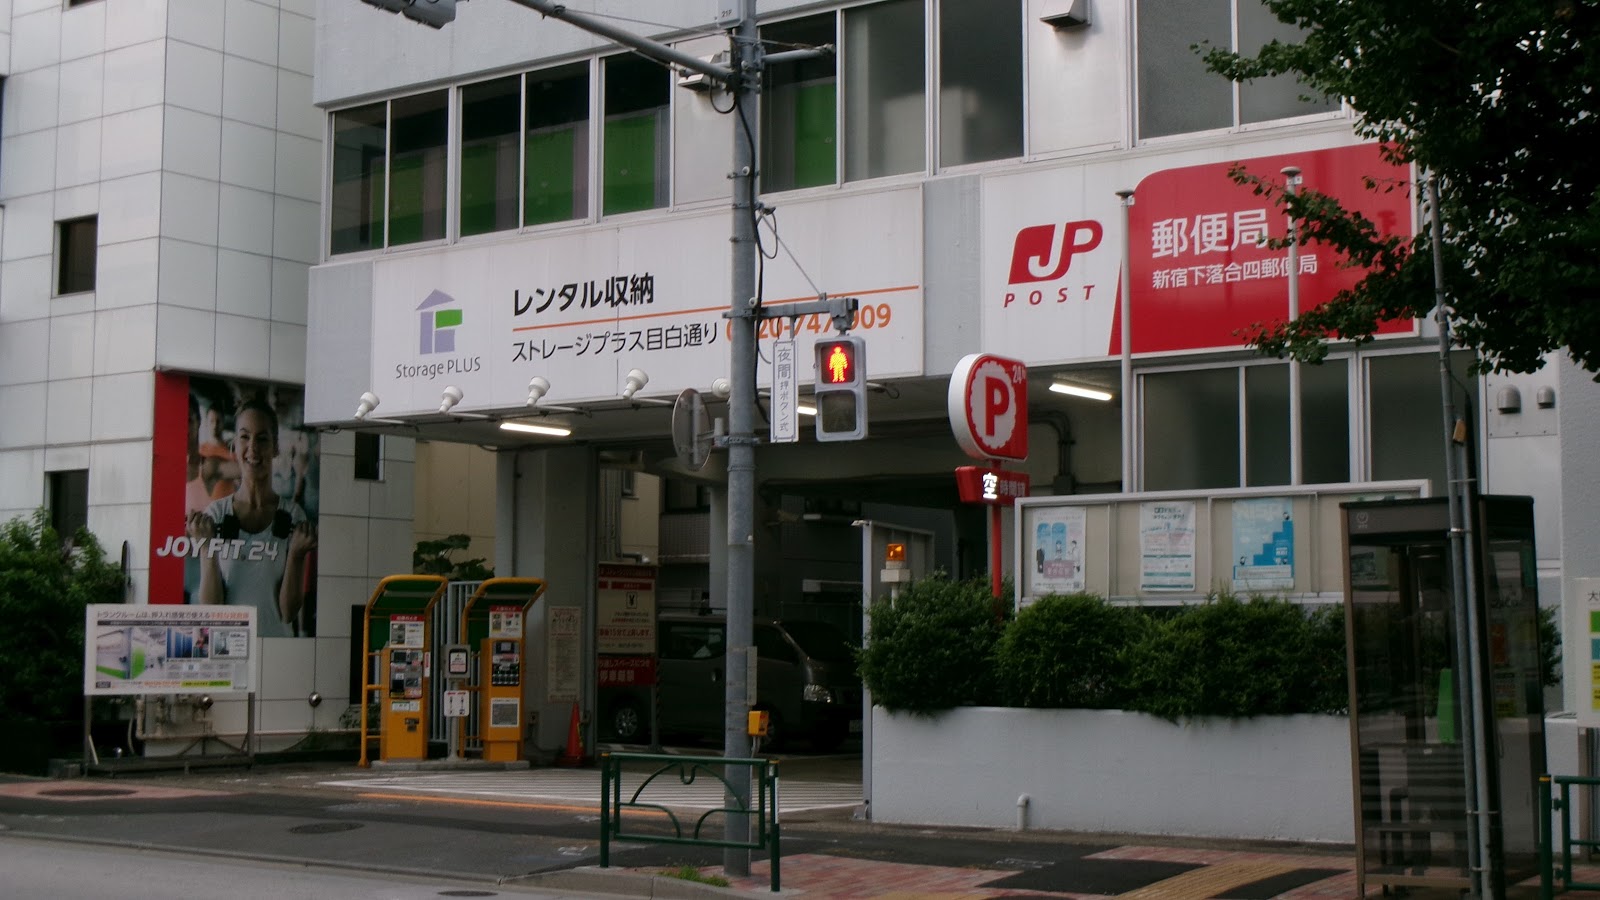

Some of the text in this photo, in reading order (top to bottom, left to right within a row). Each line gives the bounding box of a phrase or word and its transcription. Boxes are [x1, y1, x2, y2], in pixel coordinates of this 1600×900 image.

[1007, 219, 1104, 285] JP
[1151, 208, 1269, 259] 郵便局
[513, 272, 655, 317] レンタル収納
[1004, 285, 1096, 308] POST
[511, 322, 719, 363] ストレージプラス目白通り
[396, 356, 481, 380] Storage PLUS
[777, 346, 792, 432] 夜間押ボタン式
[985, 376, 1010, 437] P
[982, 471, 998, 500] 空
[247, 541, 279, 562] 24
[1587, 590, 1600, 602] 大
